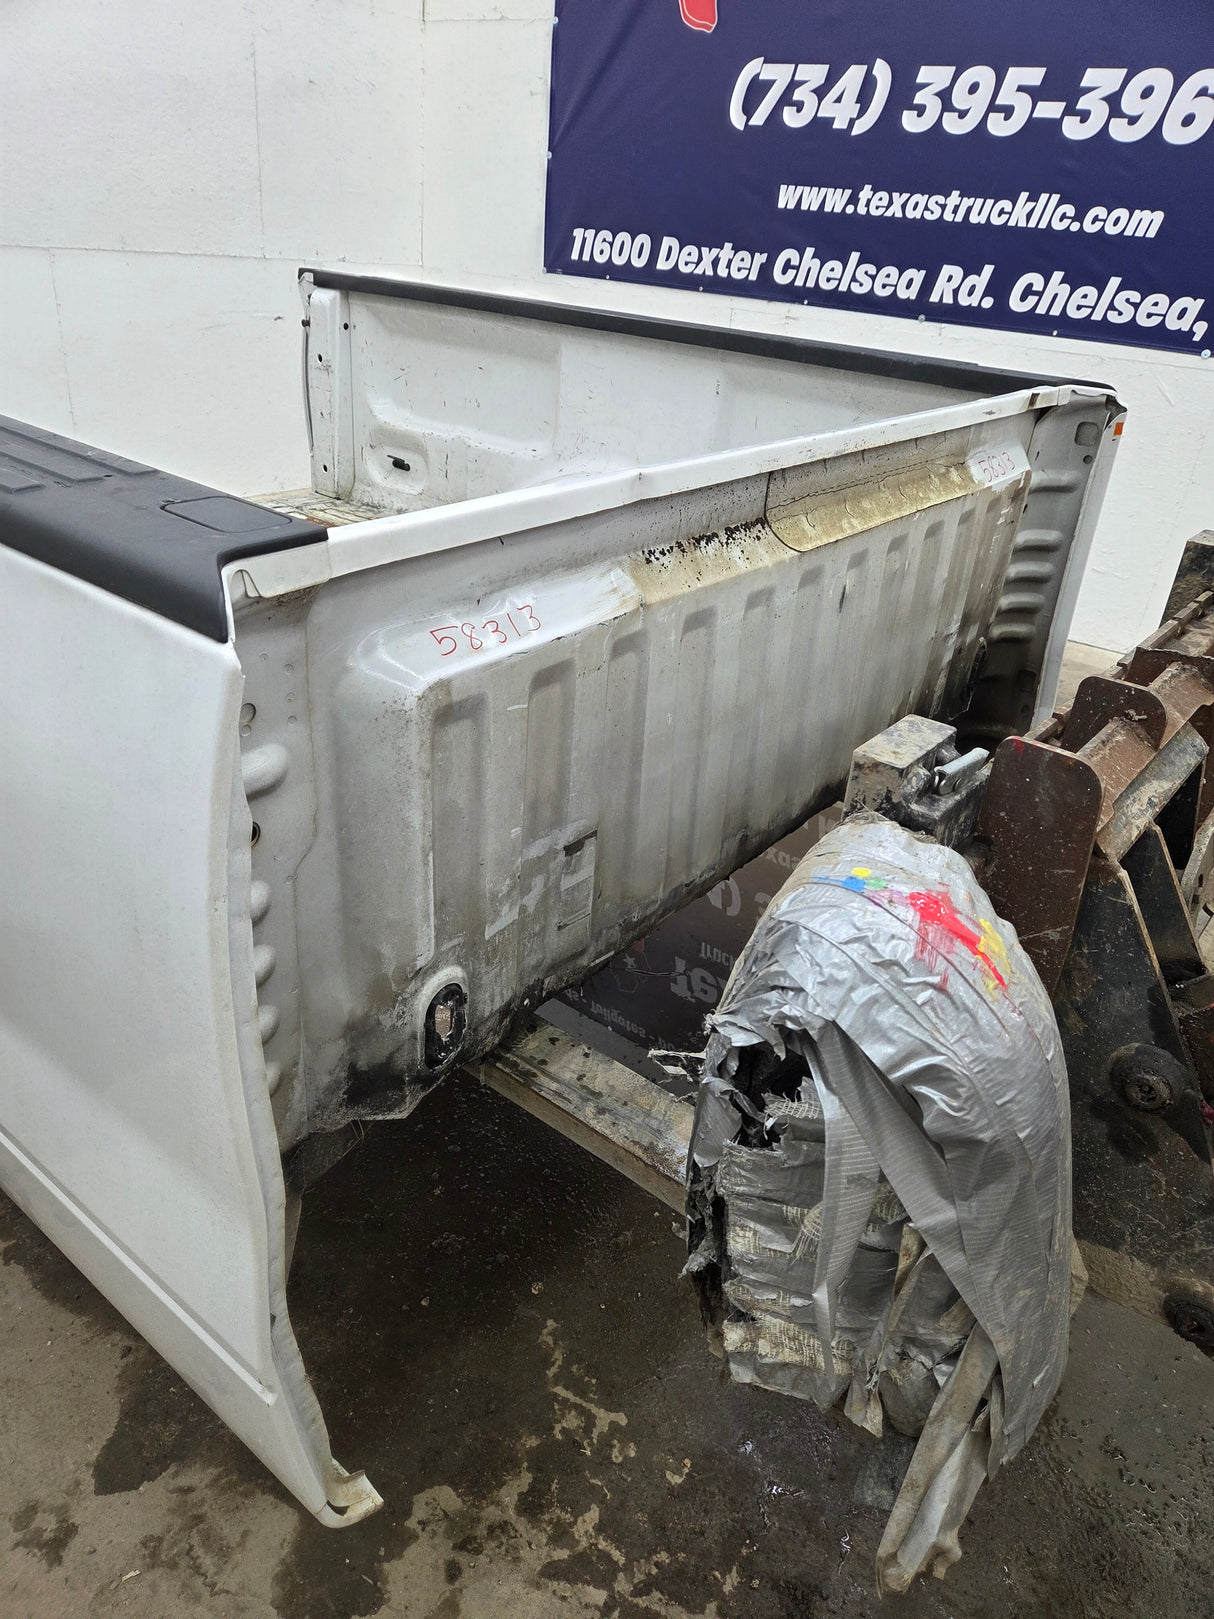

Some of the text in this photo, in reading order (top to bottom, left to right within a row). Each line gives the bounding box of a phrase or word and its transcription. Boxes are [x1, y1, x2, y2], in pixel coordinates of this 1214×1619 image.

[729, 56, 892, 137] (734)
[777, 184, 1165, 239] www.texastruckllc.com
[570, 227, 1209, 342] 11600 Dexter Chelsea Rd. Chelsea,
[977, 451, 1016, 483] 58313
[428, 604, 542, 657] 58313
